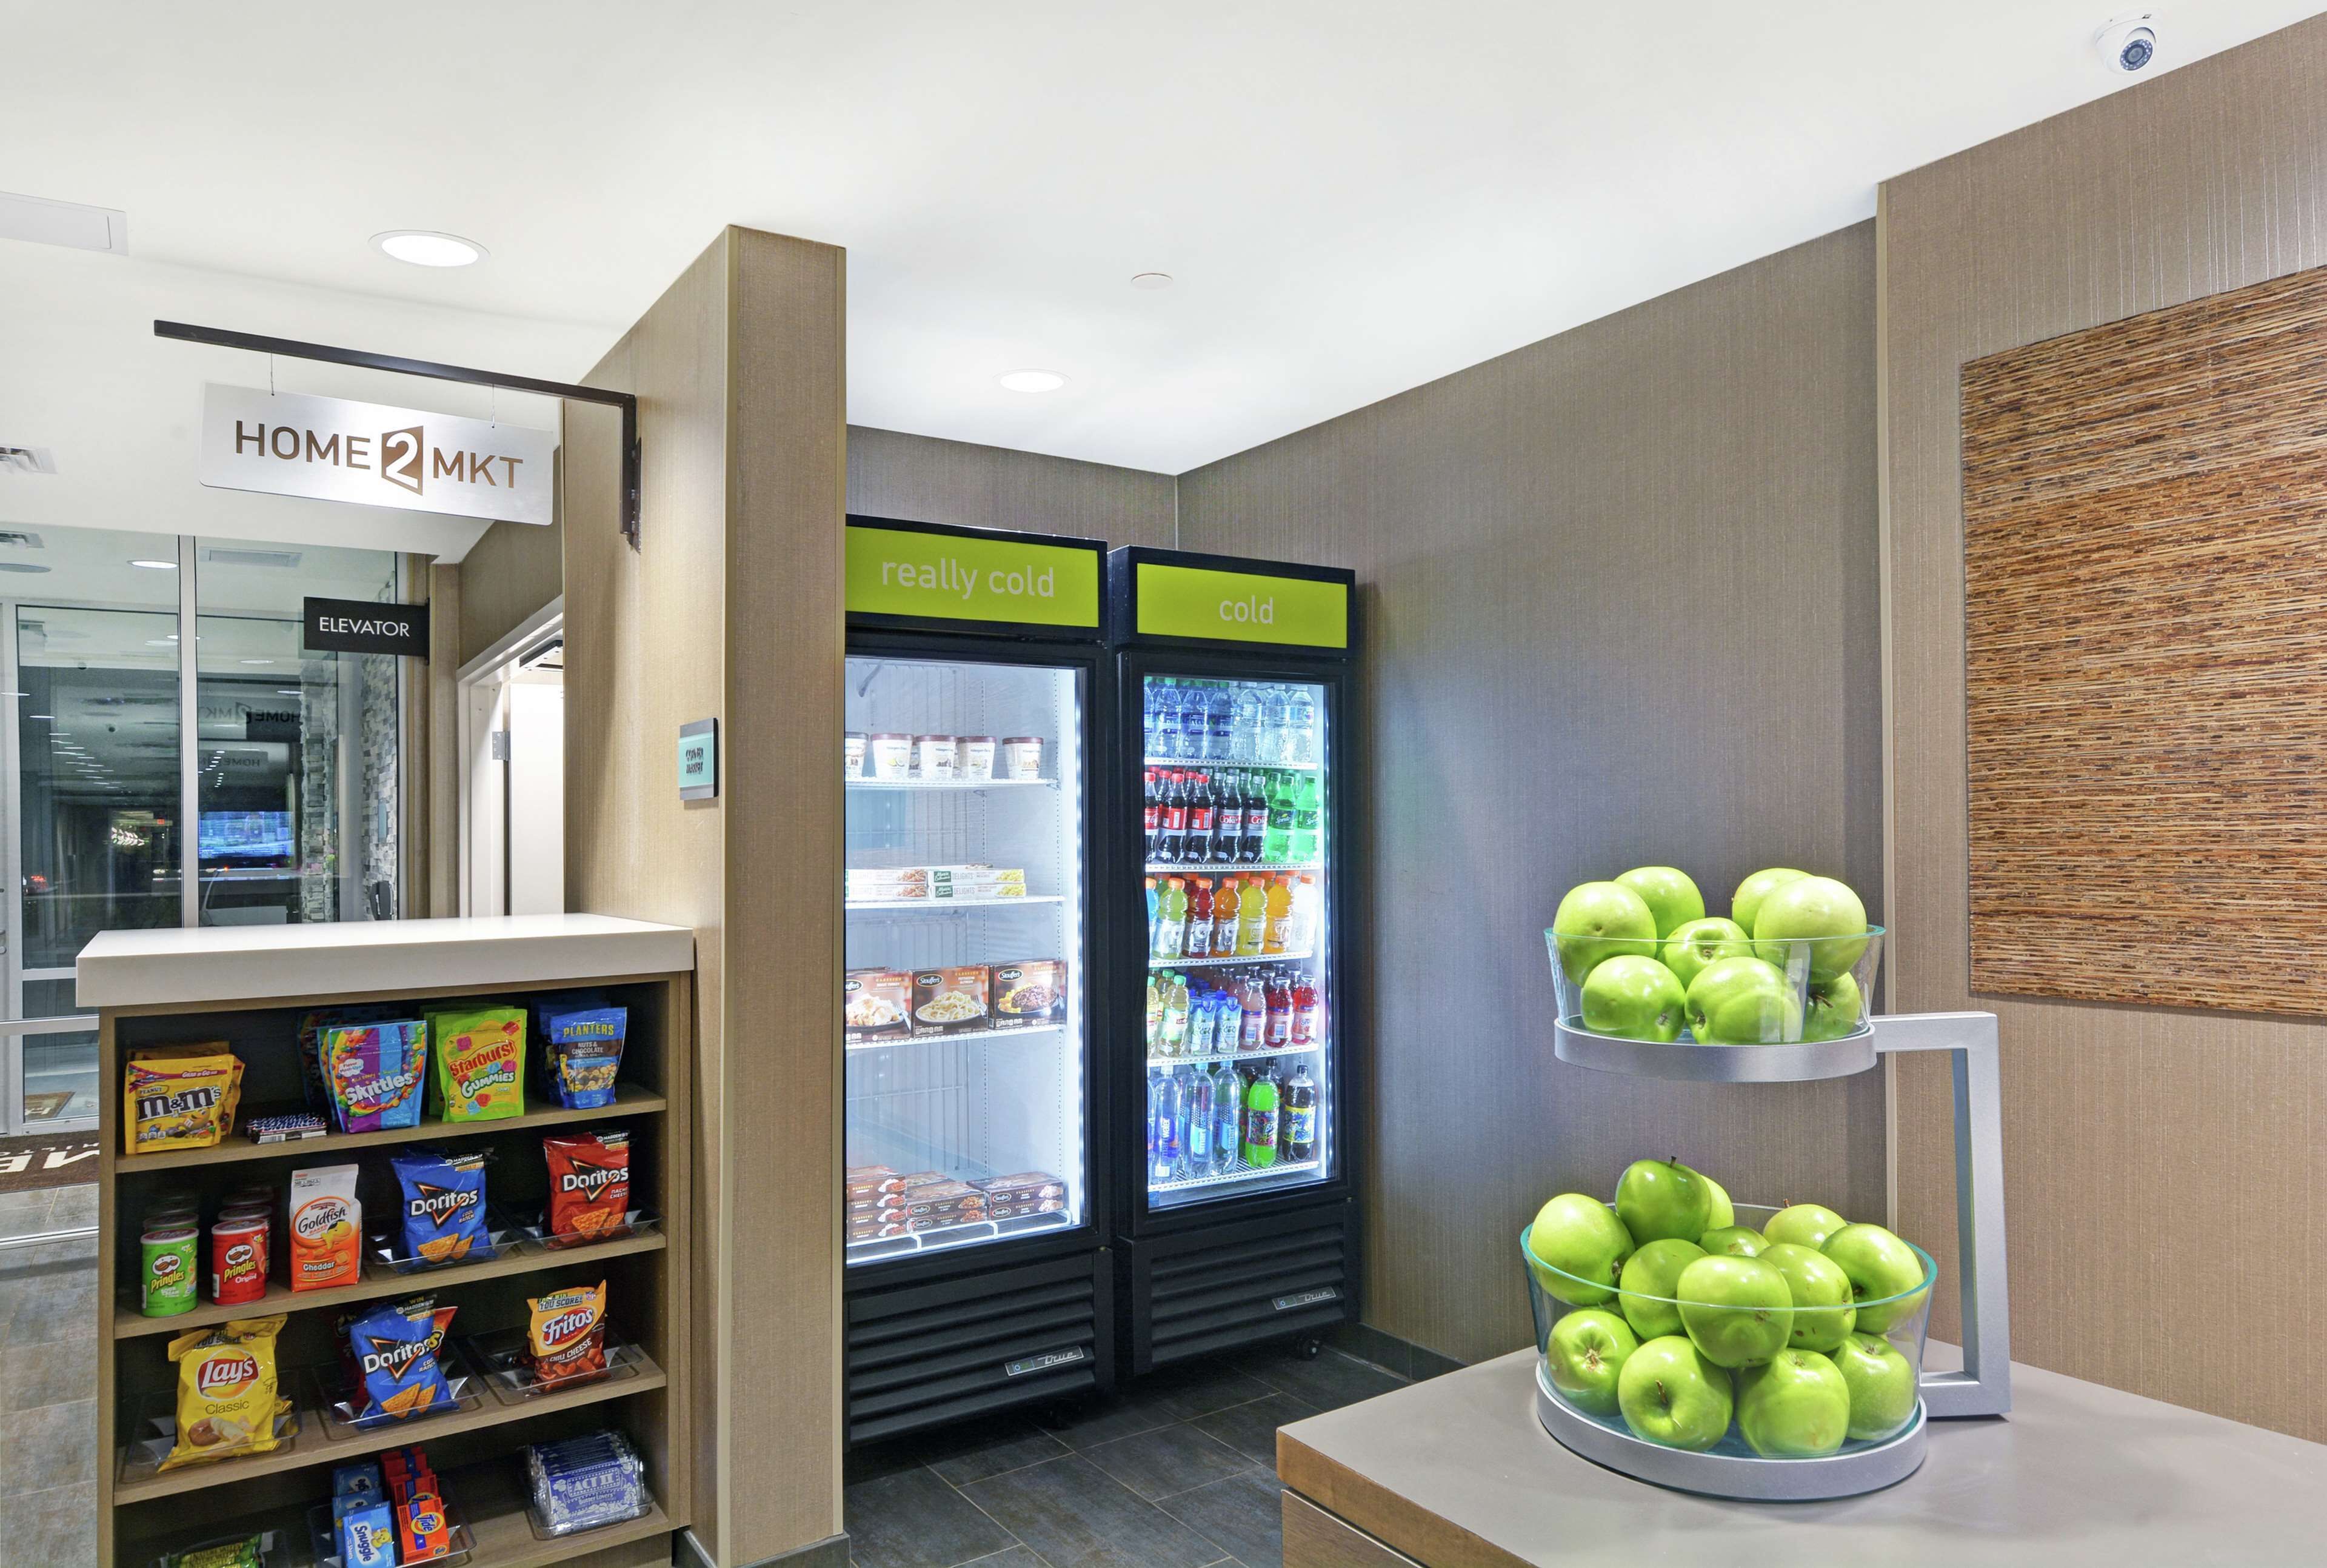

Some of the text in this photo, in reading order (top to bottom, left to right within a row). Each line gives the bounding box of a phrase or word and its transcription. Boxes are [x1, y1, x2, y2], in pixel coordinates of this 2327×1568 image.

[235, 419, 524, 493] HOME 2 MKT
[881, 557, 1055, 599] really cold
[1219, 596, 1274, 624] cold
[318, 615, 410, 638] ELEVATOR
[919, 976, 941, 985] Stouffer's
[1001, 971, 1021, 979] Stouffer's
[563, 1024, 615, 1038] PLANTERS
[449, 1041, 515, 1078] Starburst
[345, 1072, 414, 1106] Skittles
[461, 1070, 515, 1098] GUMMIES
[136, 1086, 222, 1121] m&m's
[563, 1167, 629, 1192] Doritos
[411, 1189, 478, 1216] Doritos
[298, 1207, 347, 1234] Goldfish
[224, 1259, 256, 1283] Pringles
[302, 1261, 335, 1271] Cheddar
[150, 1270, 185, 1295] Pringles
[539, 1300, 555, 1310] YOU
[556, 1296, 583, 1307] SCORE!
[541, 1309, 593, 1346] Fritos
[567, 1337, 593, 1358] CHEESE
[202, 1356, 253, 1389] Lay's
[205, 1399, 250, 1415] Classic
[573, 1473, 615, 1492] ACT II
[596, 1492, 614, 1502] Lovers
[416, 1513, 435, 1532] Tide
[354, 1525, 372, 1563] Snuggle
